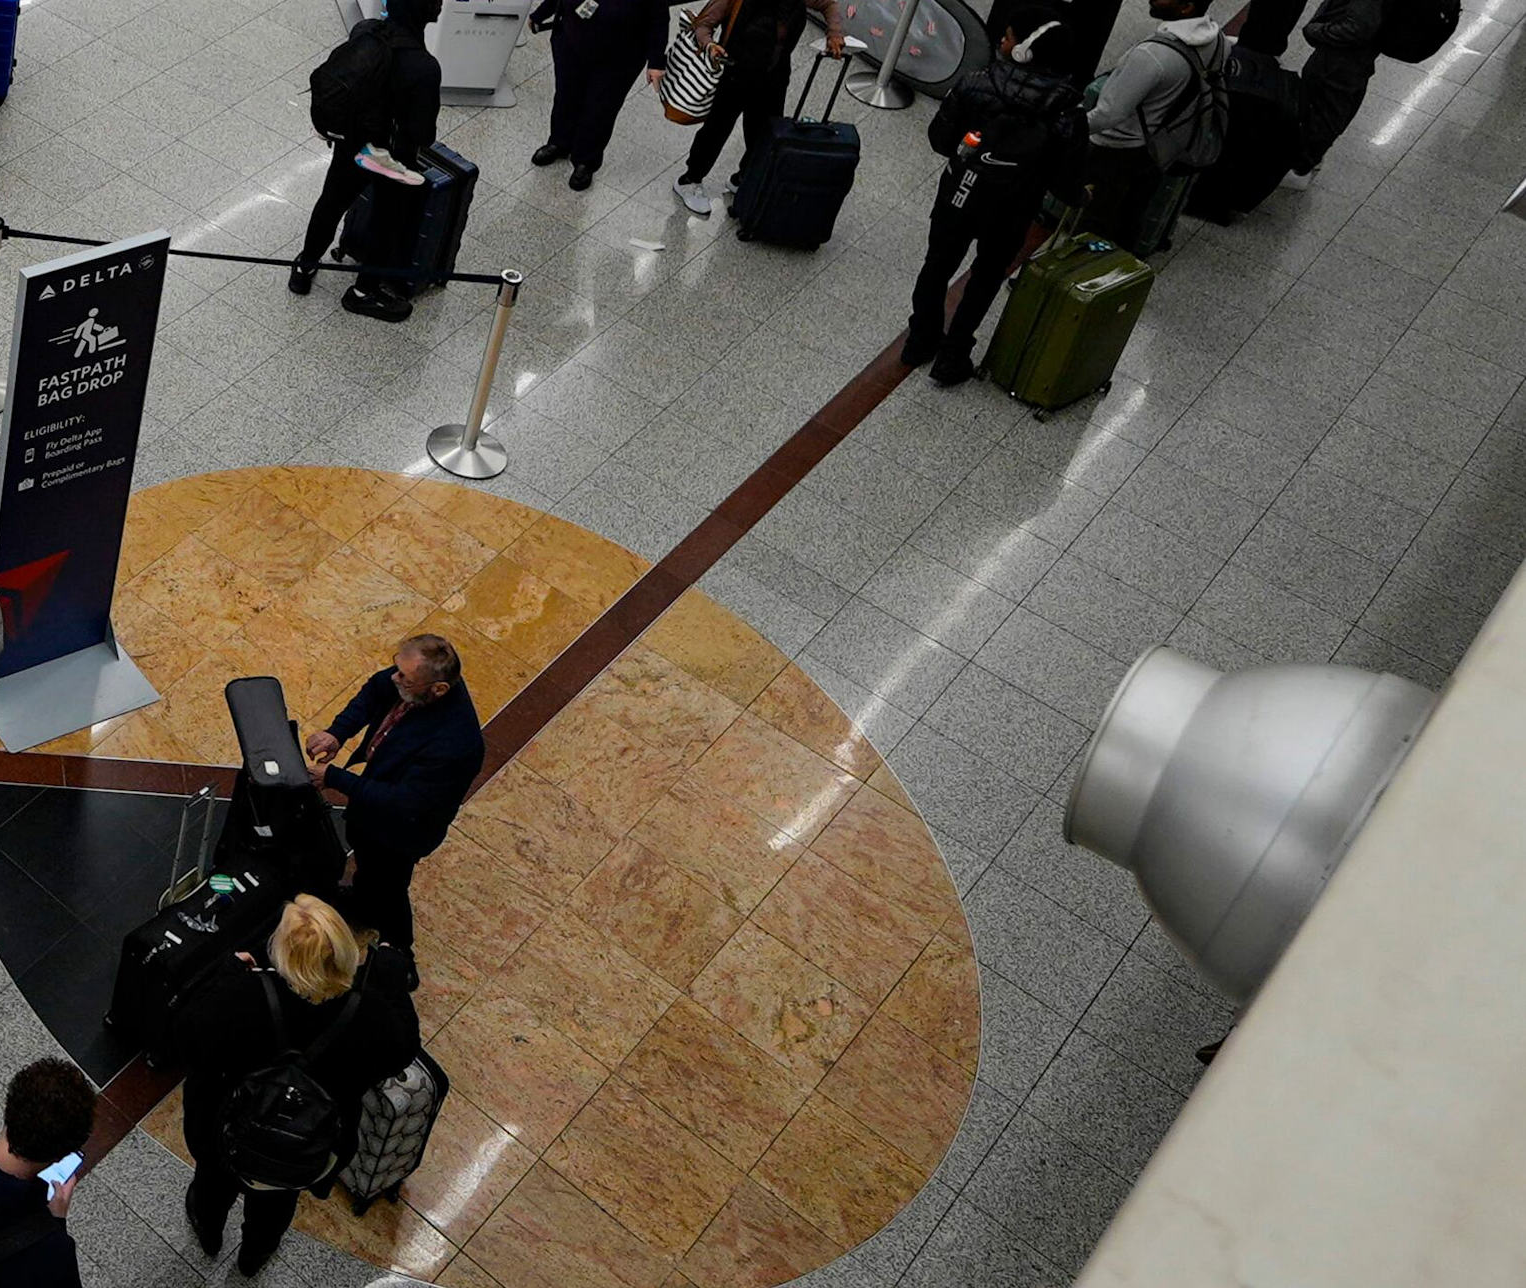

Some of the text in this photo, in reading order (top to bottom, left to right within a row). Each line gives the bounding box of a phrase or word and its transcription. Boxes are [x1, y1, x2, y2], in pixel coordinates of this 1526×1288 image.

[951, 170, 978, 208] ELITE
[63, 262, 132, 292] DELTA
[38, 354, 127, 392] FASTPATH
[37, 371, 124, 407] BAG DROP
[23, 414, 86, 441] ELIGIBILITY:
[46, 427, 103, 452] Fly Delta App
[44, 436, 103, 460] Boarding Pass
[41, 457, 126, 490] Complimentary Bags
[42, 464, 75, 481] Prepaid
